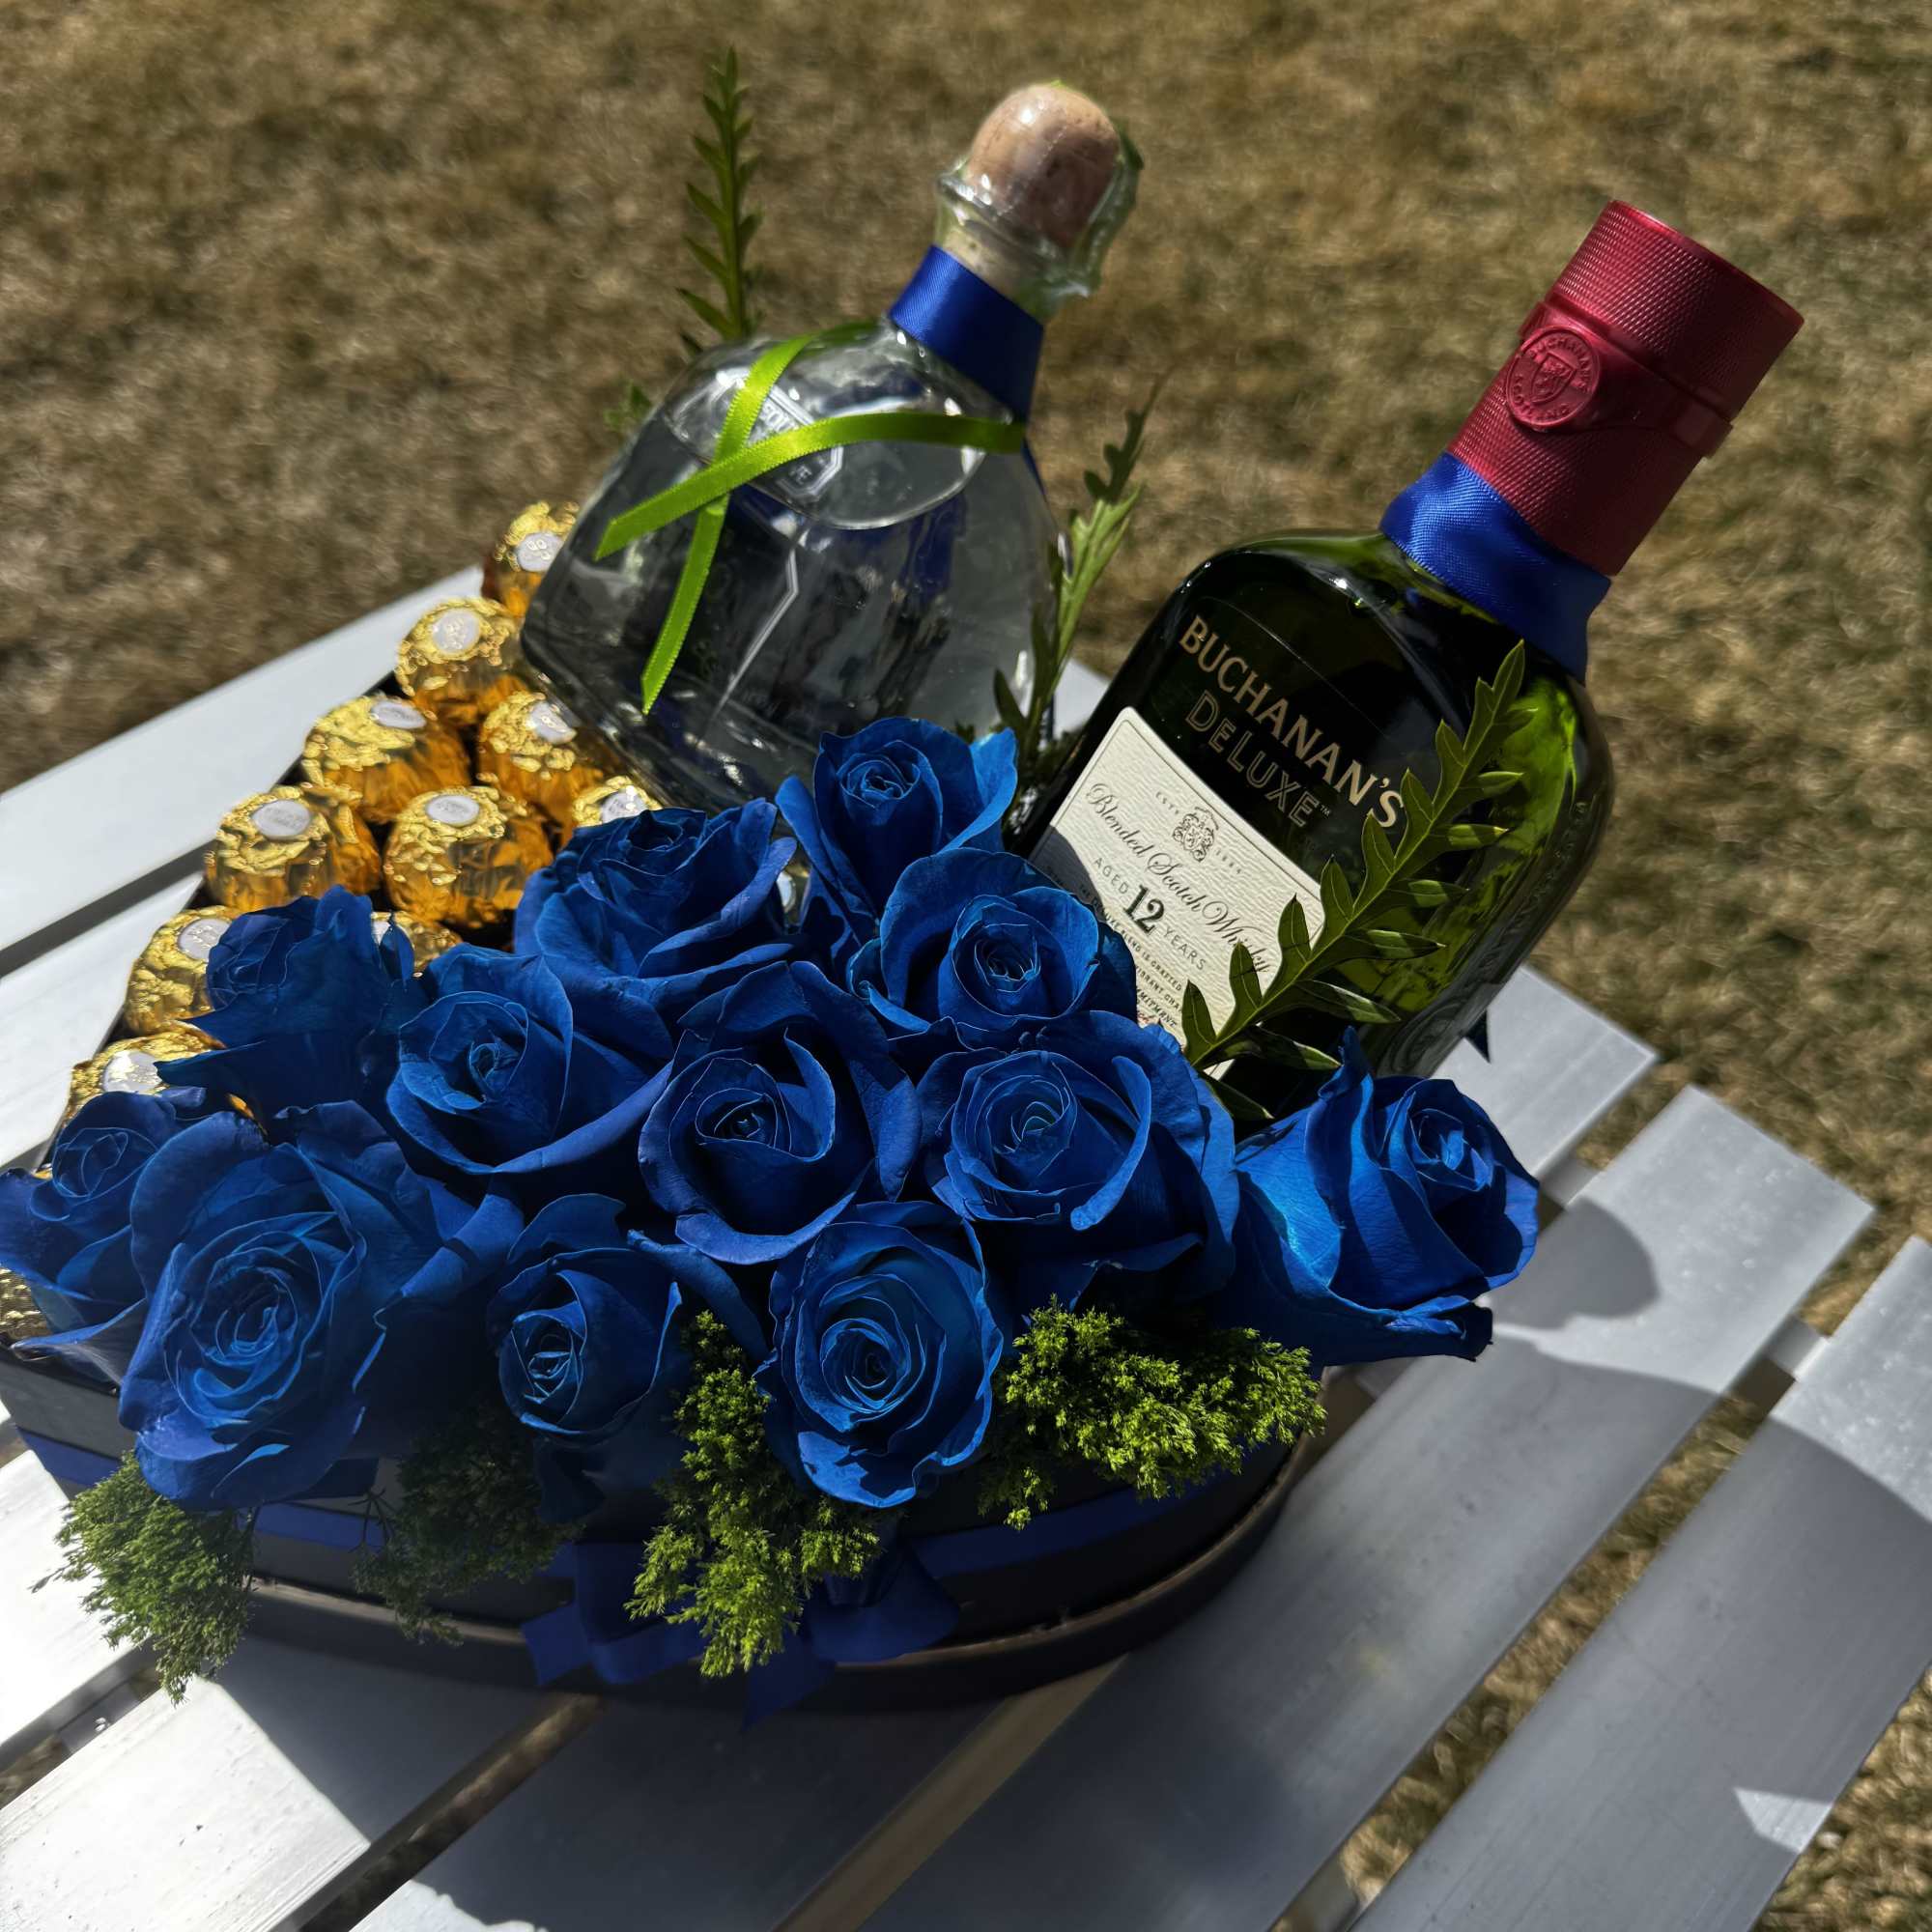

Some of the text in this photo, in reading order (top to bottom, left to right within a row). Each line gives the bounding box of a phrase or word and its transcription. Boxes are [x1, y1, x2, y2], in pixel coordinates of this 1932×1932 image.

[1179, 614, 1405, 828] BUCHANAN'S
[1086, 782, 1270, 979] Blended Scotch Whiky
[1094, 858, 1129, 895] AGED
[1123, 884, 1165, 934] 12
[1164, 925, 1207, 972] YEARS
